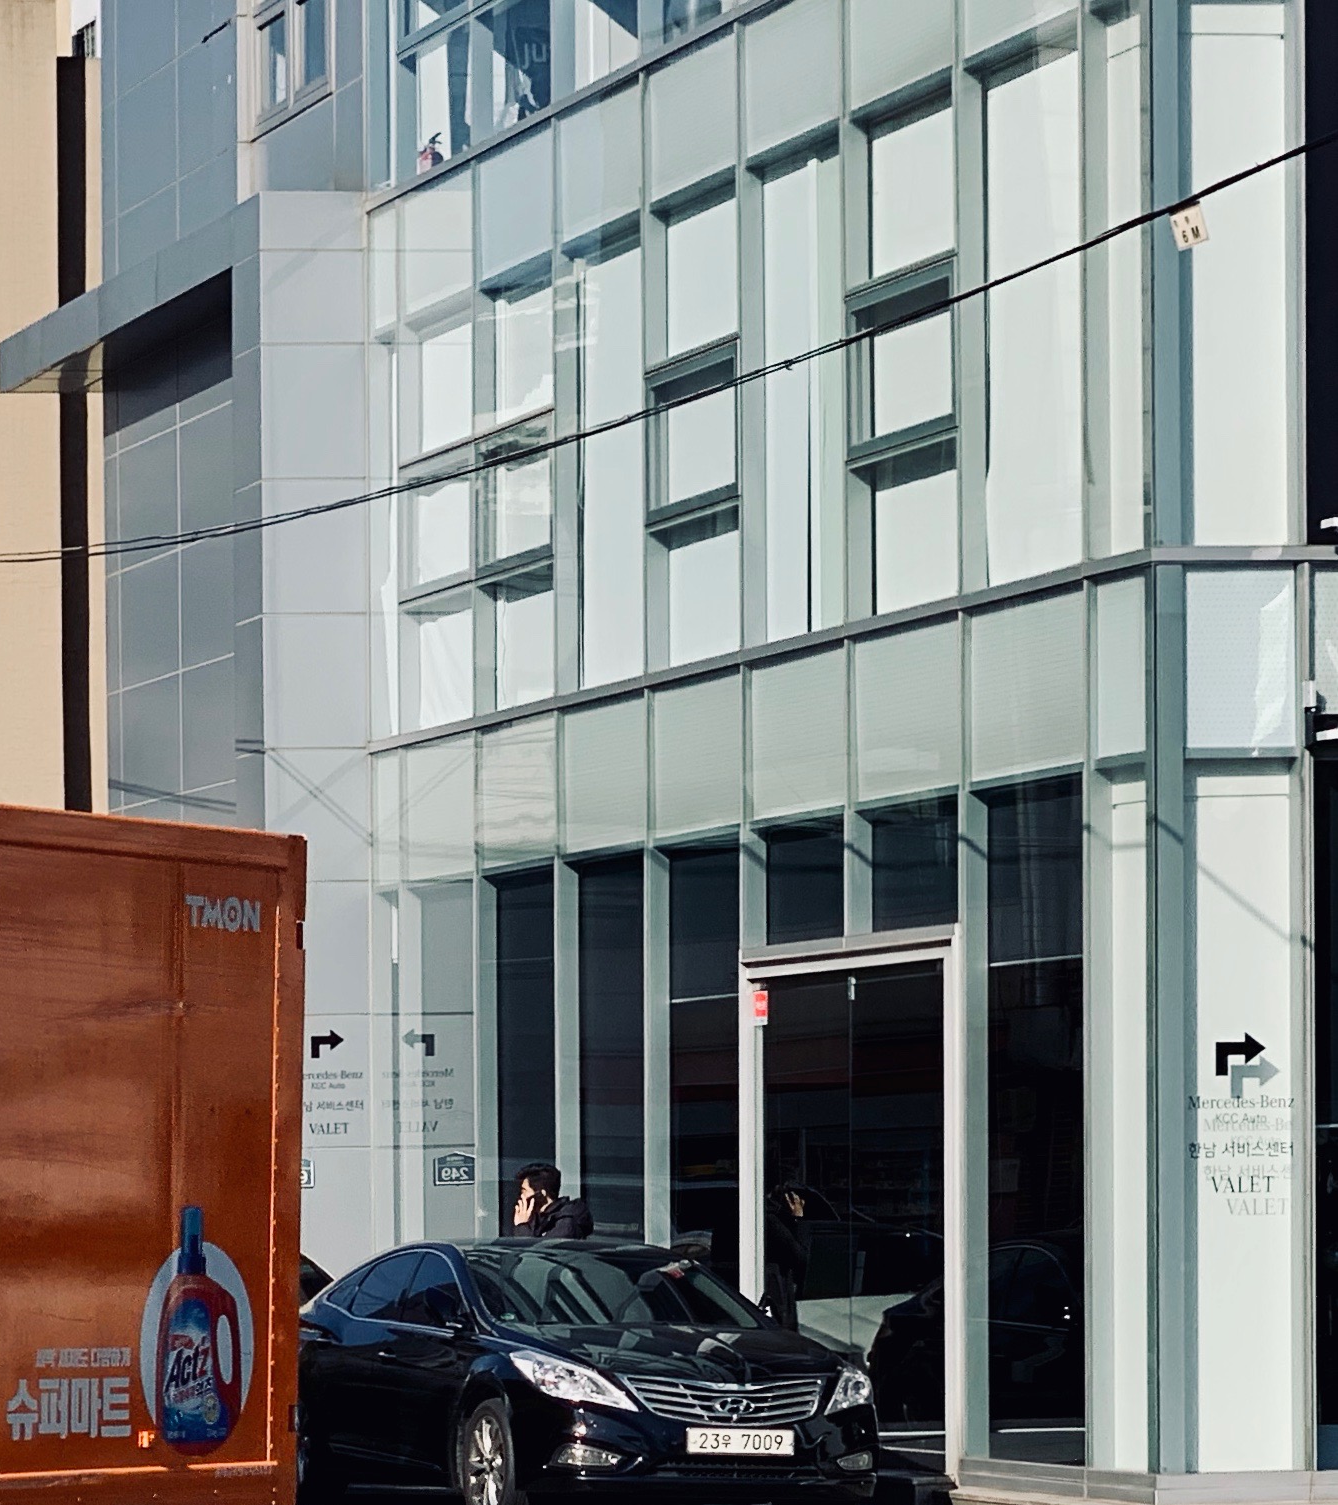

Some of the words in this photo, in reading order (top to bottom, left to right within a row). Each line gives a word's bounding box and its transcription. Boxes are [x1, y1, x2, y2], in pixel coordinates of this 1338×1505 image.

[185, 893, 261, 933] TMON
[1188, 1094, 1295, 1110] Mercedes-Benz
[309, 1122, 349, 1135] VALET
[1211, 1175, 1275, 1194] VALET
[6, 1378, 132, 1440] 슈퍼마트
[741, 1434, 784, 1451] 7009
